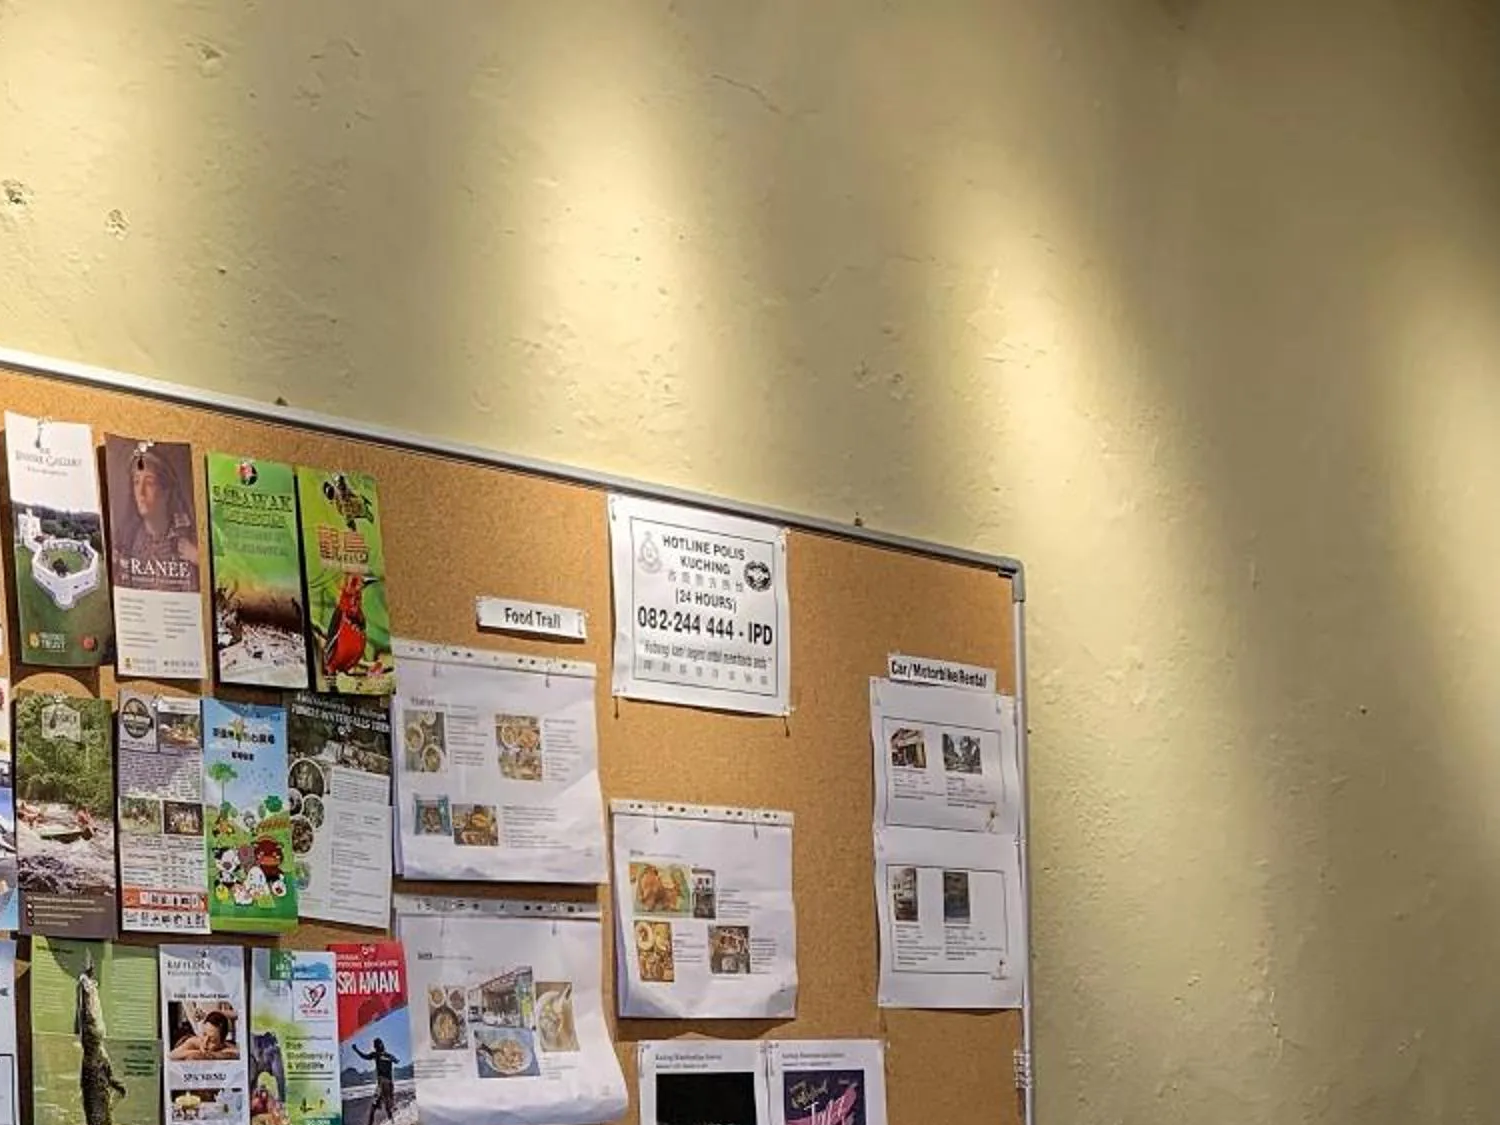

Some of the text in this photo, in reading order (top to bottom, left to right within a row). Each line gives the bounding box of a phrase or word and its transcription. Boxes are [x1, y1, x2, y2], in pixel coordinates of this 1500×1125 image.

[663, 535, 745, 561] HOTLINE POLIS
[680, 556, 730, 575] KUCHING
[676, 588, 737, 614] (24 HOURS)
[505, 607, 561, 629] Food Trail
[638, 606, 701, 634] 082-244
[706, 616, 734, 640] 444
[748, 621, 773, 645] IPD
[360, 969, 400, 993] AMAN
